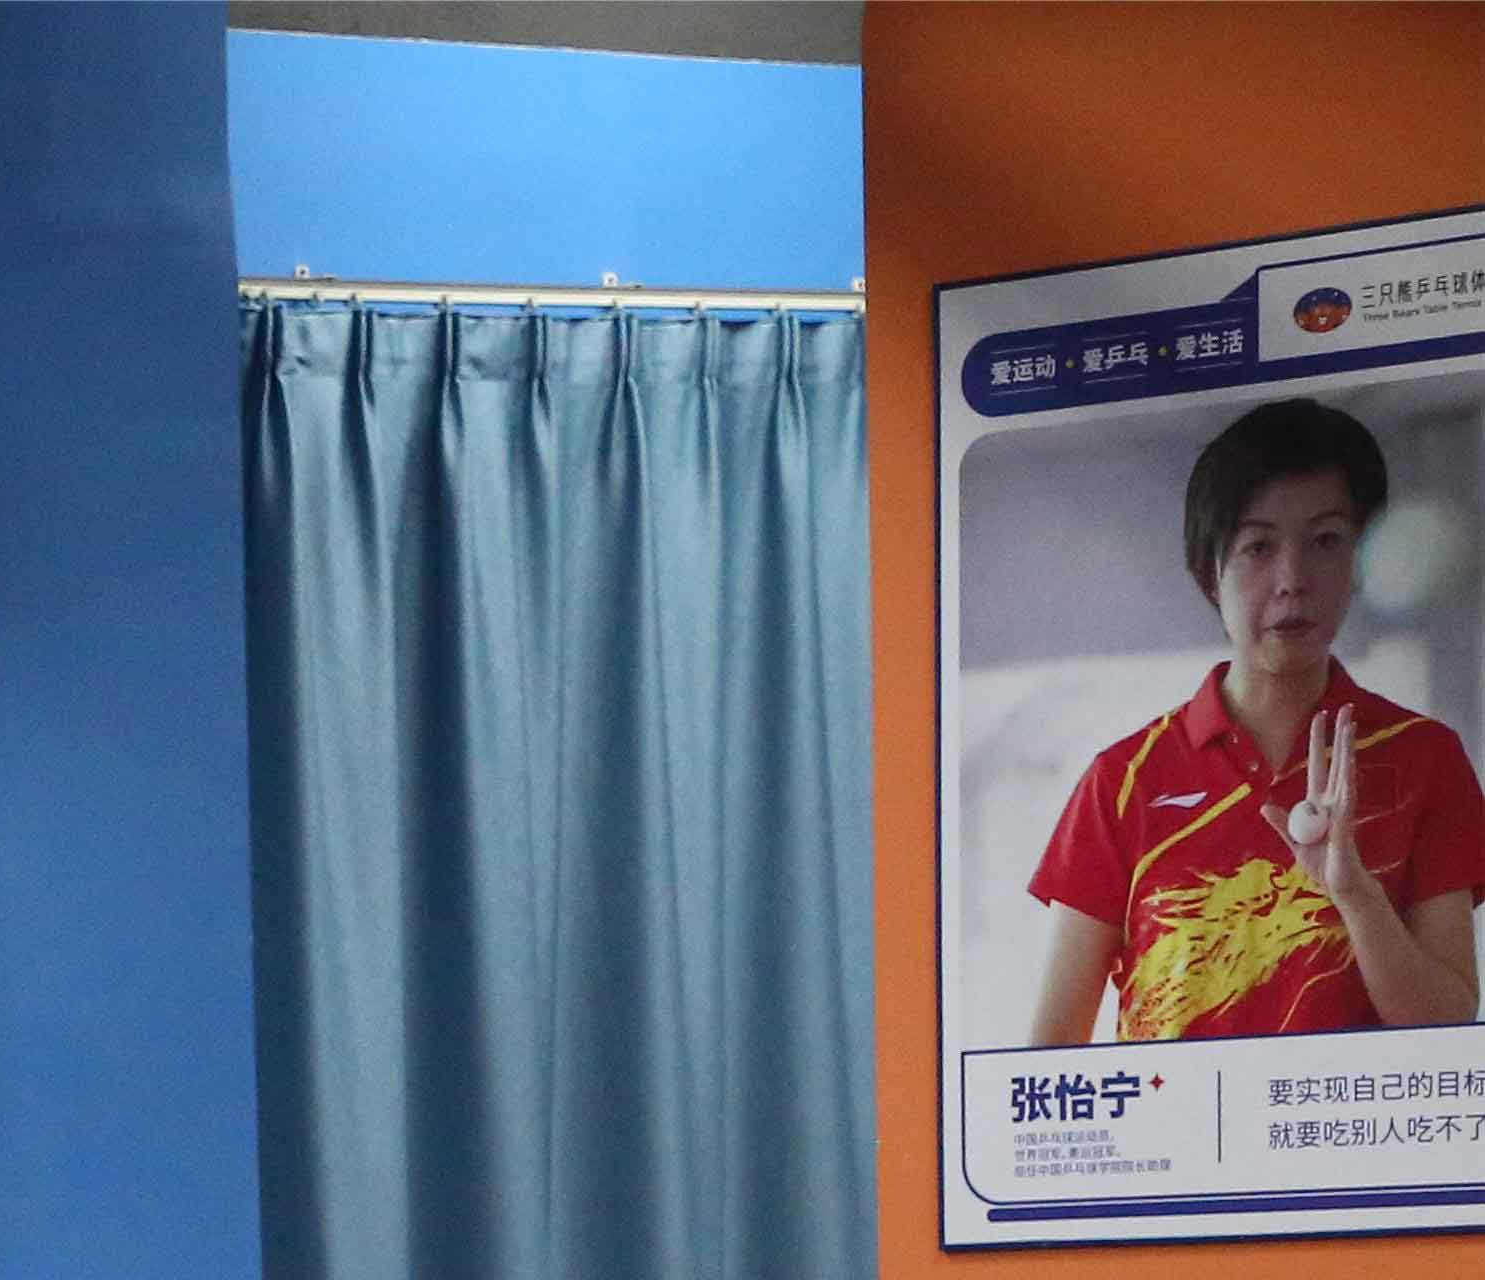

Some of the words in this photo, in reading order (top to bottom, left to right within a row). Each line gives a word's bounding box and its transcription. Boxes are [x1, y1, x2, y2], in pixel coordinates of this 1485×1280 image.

[990, 354, 1056, 386] 爱运动
[1082, 342, 1149, 374] 爱乒乓
[1175, 328, 1244, 362] 爱生活
[1011, 1071, 1141, 1123] 张怡宁
[1268, 1067, 1485, 1107] 要实现自己的目标
[1267, 1114, 1485, 1150] 就要吃别人吃不了
